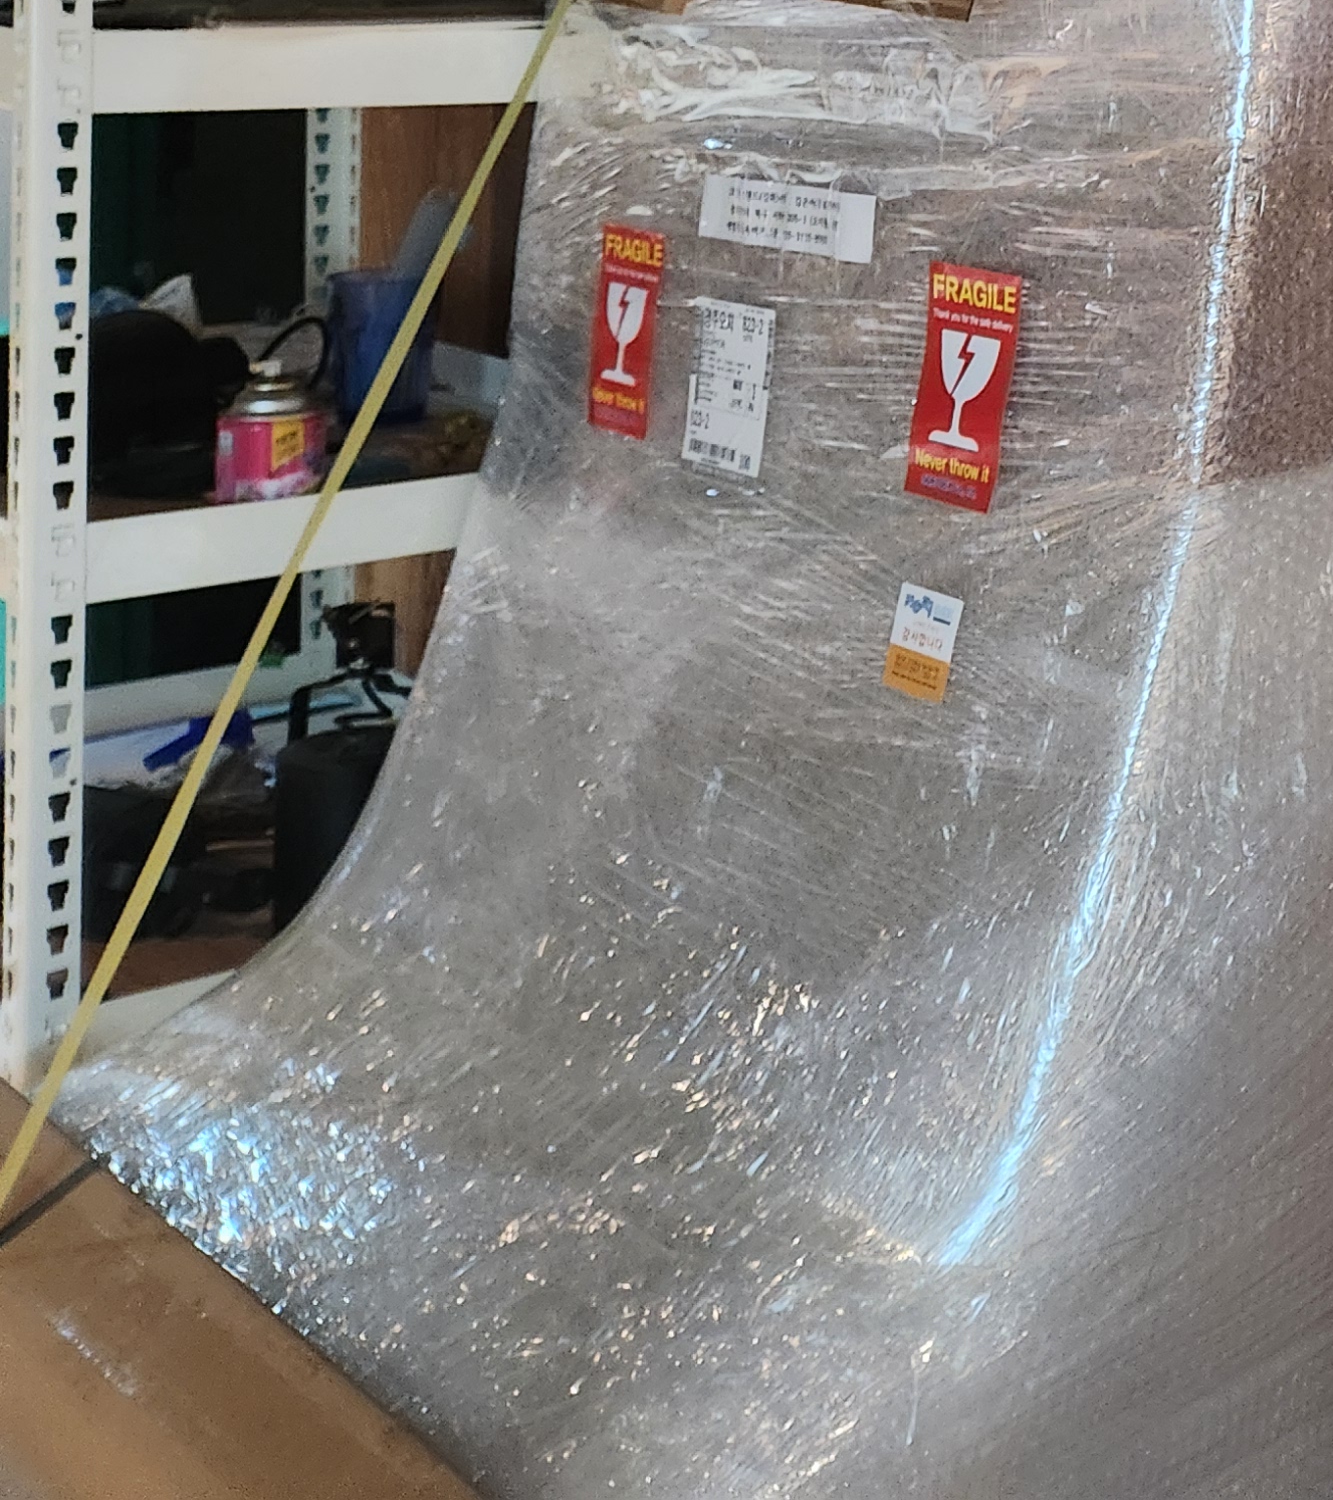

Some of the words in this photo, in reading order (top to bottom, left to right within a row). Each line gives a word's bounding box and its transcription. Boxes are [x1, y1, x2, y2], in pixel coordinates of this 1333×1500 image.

[605, 233, 664, 268] FRAGILE
[932, 272, 1017, 316] FRAGILE
[915, 448, 946, 473] Never
[949, 455, 980, 480] throw
[980, 463, 990, 484] it
